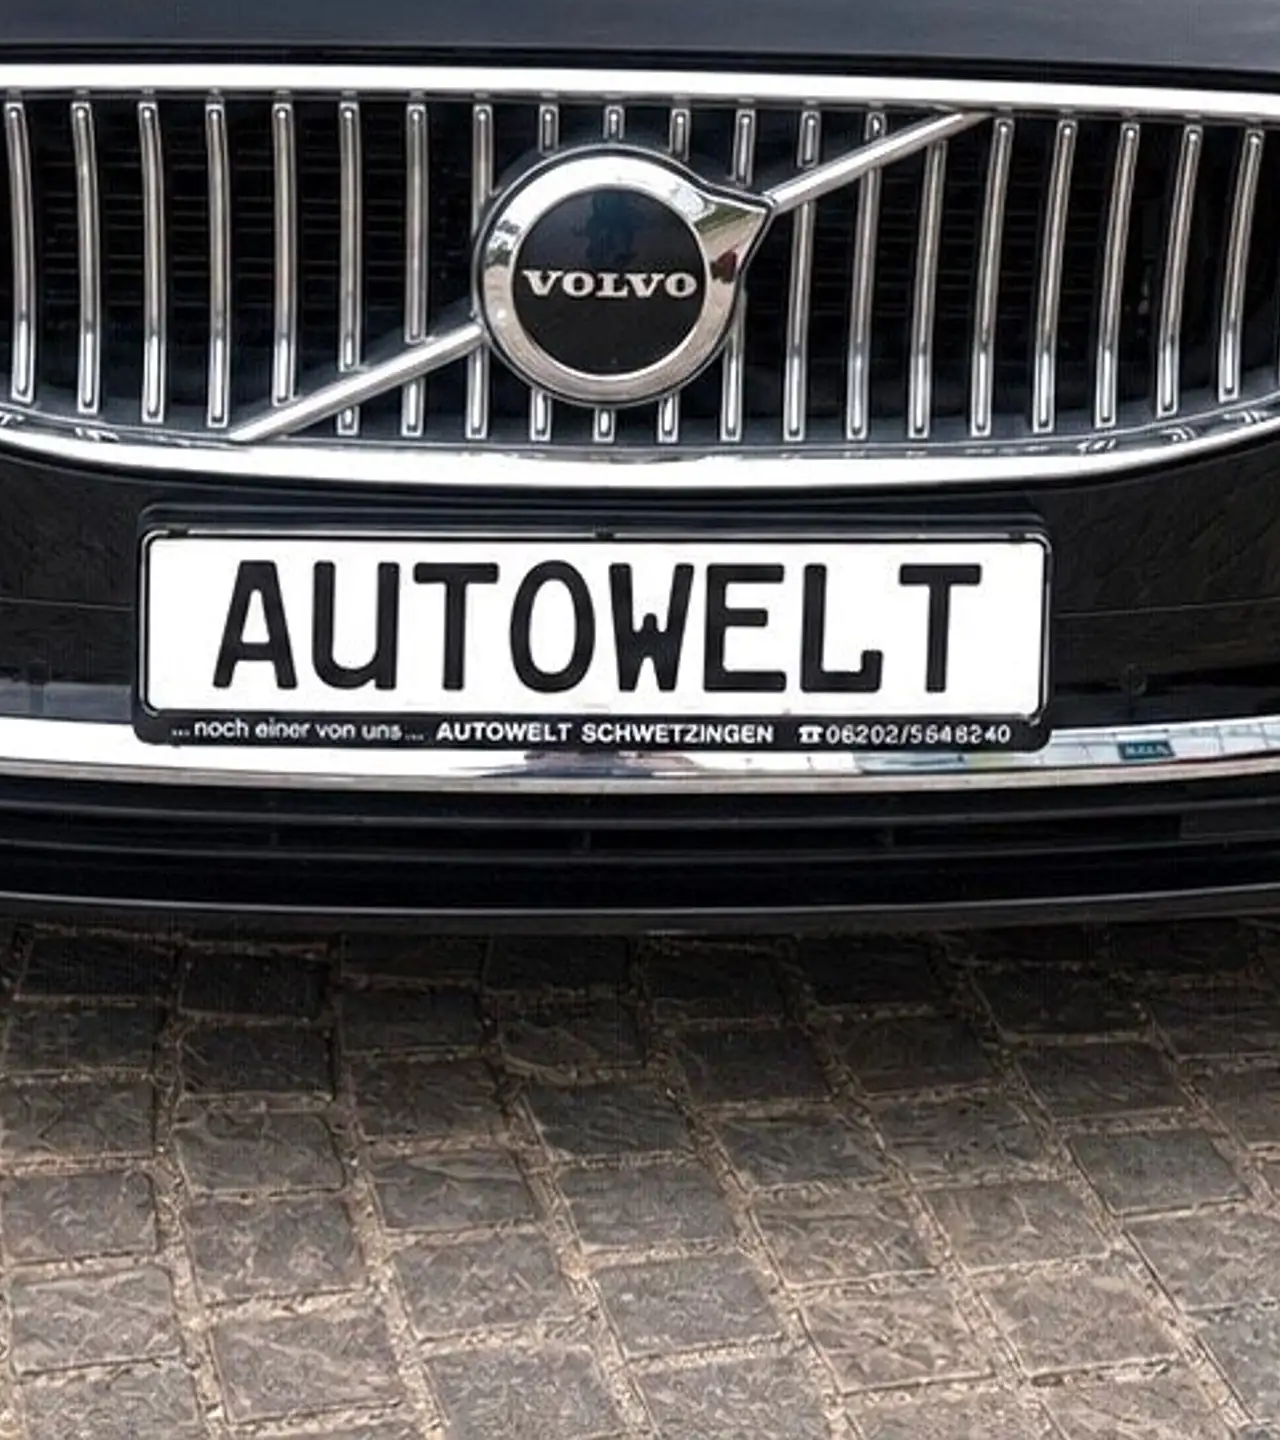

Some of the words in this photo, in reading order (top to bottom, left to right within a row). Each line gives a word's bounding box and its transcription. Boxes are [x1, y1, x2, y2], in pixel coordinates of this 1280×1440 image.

[523, 270, 697, 298] VOLVO
[213, 561, 982, 693] AUTOWELT
[254, 718, 311, 740] einer
[315, 723, 355, 740] von
[436, 722, 572, 742] AUTOWELT
[581, 723, 774, 744] SCHWETZINGEN
